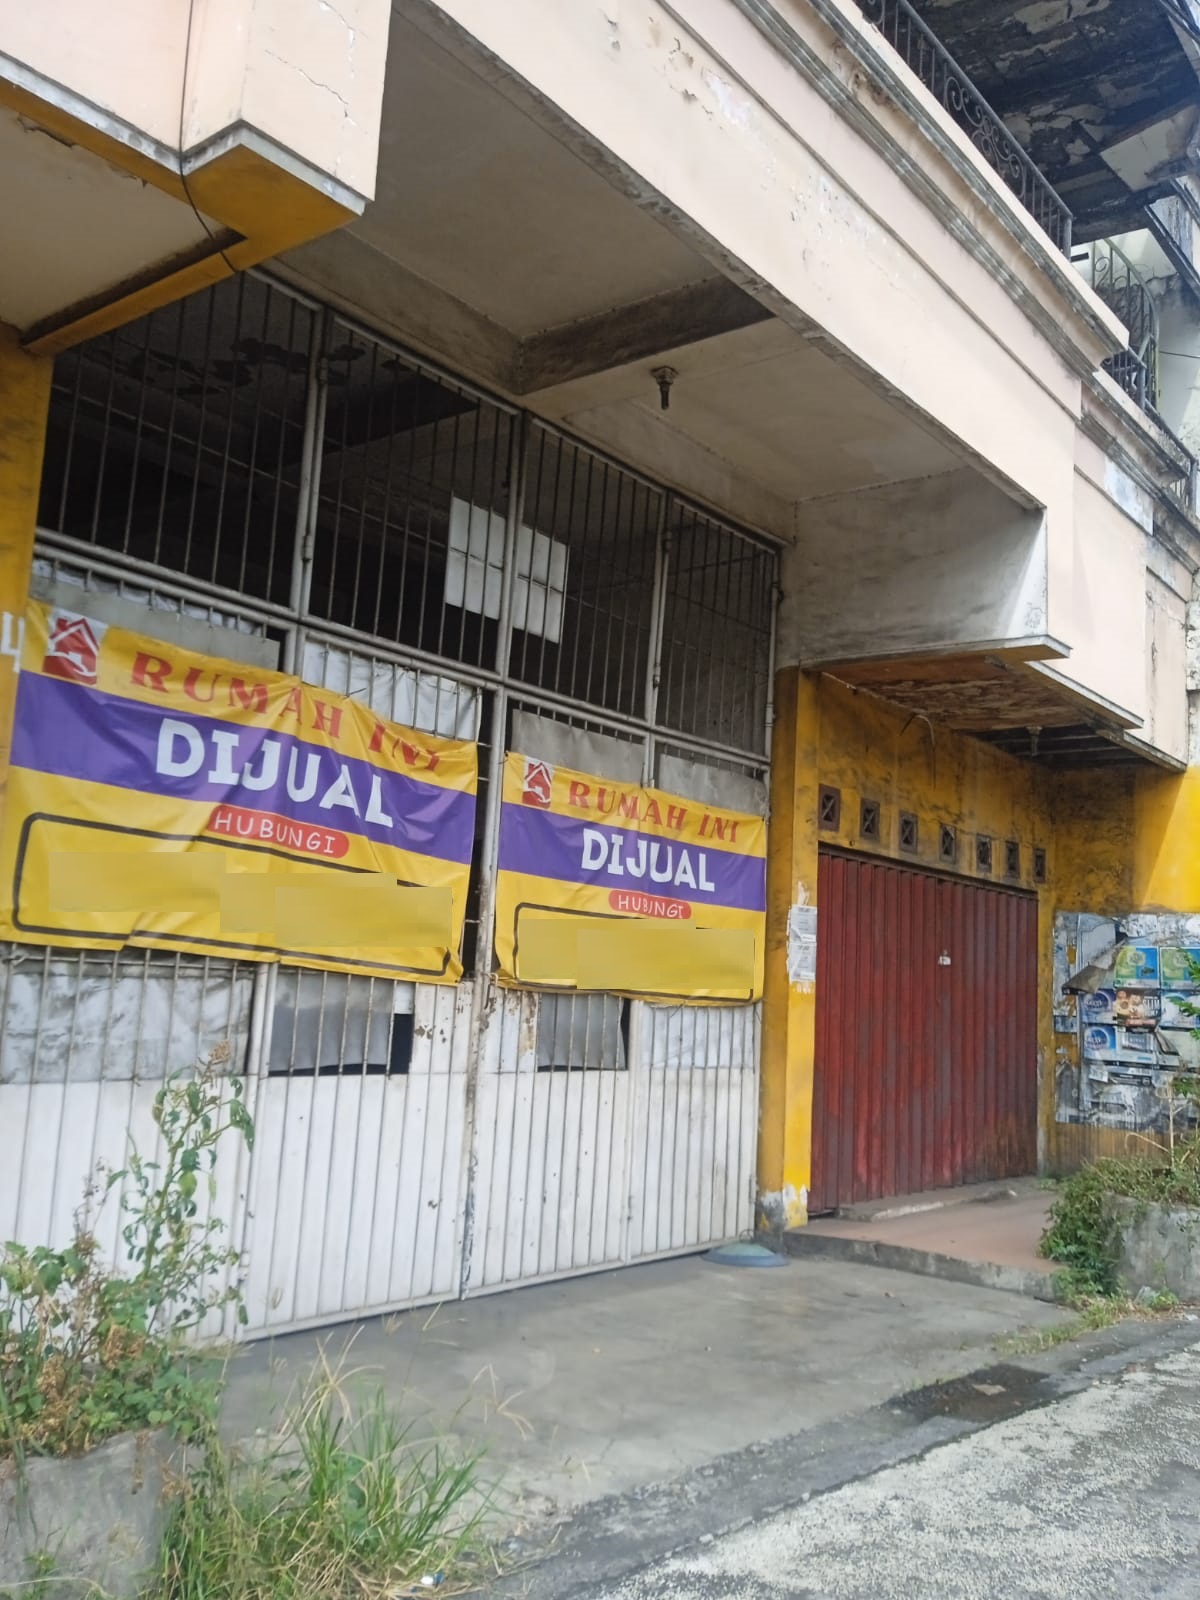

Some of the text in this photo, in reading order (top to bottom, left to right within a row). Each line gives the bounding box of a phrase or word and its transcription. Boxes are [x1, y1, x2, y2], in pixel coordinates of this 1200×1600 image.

[130, 651, 440, 772] RUMAH INI
[156, 717, 393, 828] DIJUAL
[214, 810, 336, 854] HUBUNGI
[568, 780, 740, 843] RUMAH INI
[581, 828, 715, 892] DIJUAL
